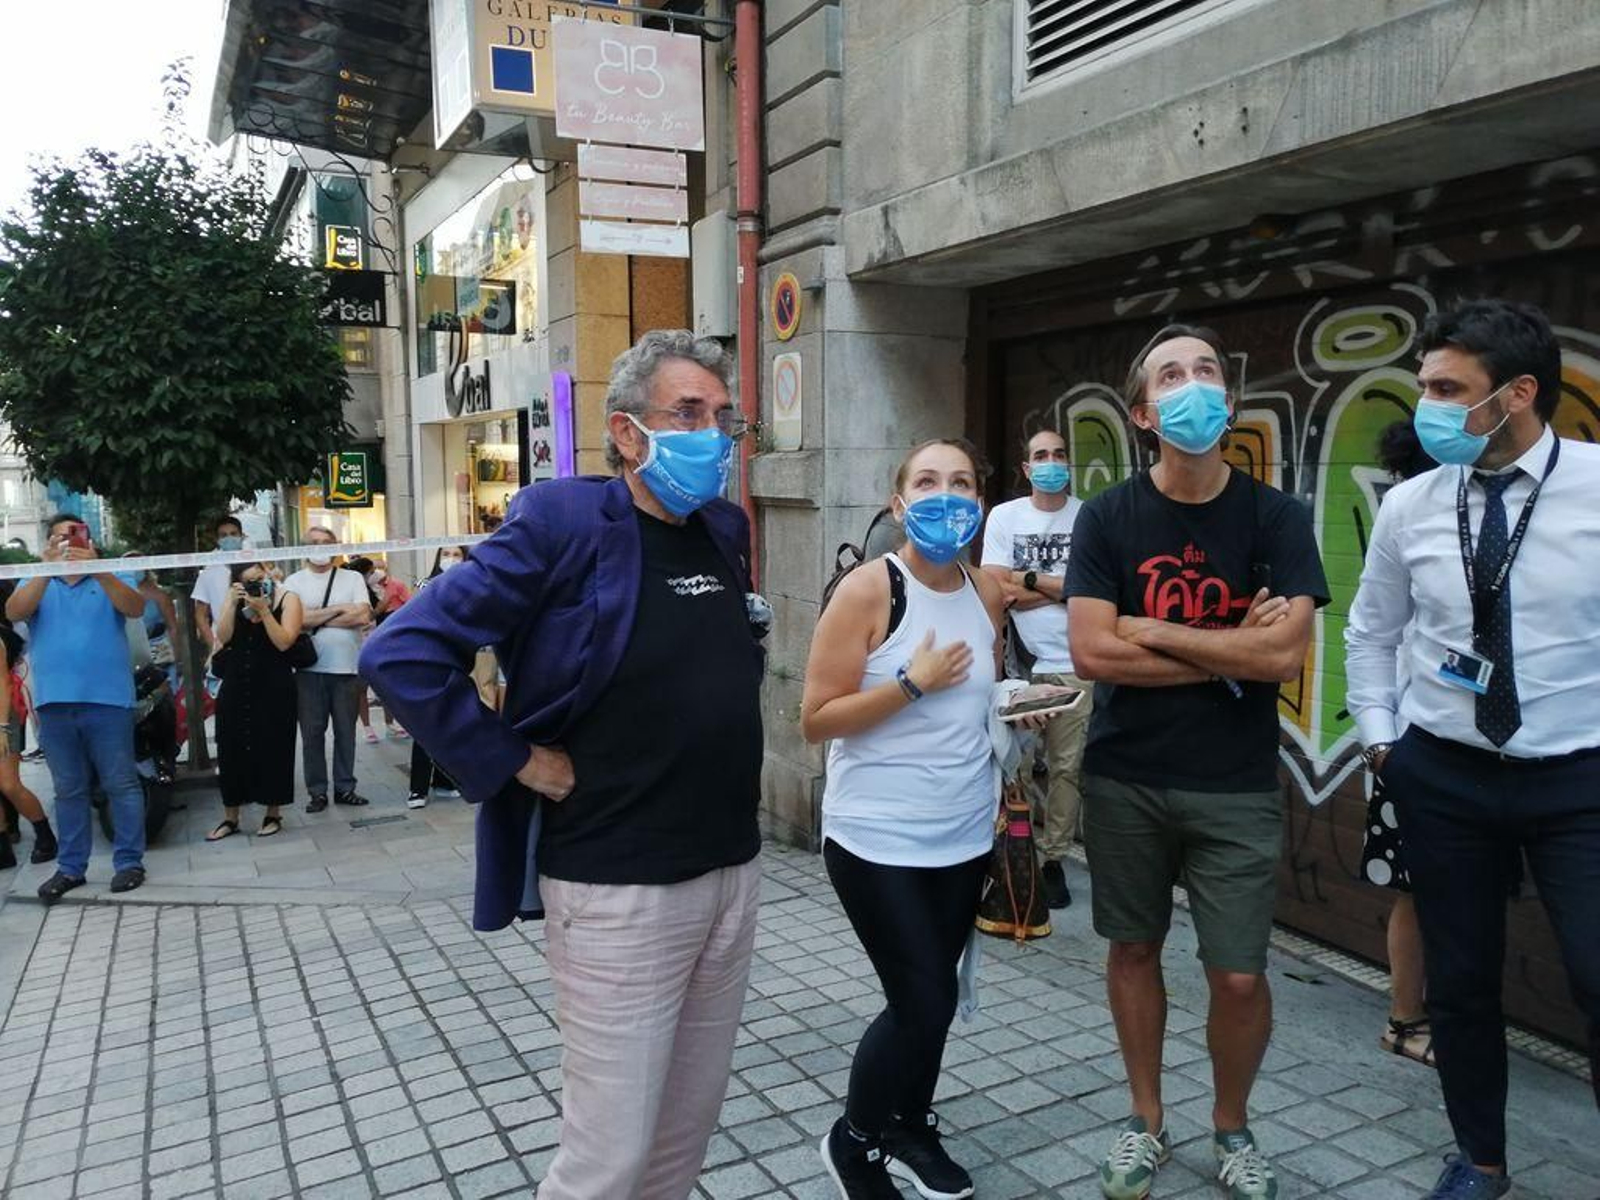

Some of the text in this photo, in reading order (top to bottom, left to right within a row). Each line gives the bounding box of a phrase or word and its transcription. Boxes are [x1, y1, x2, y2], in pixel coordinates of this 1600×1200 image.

[593, 104, 651, 131] Beauty
[340, 461, 362, 471] Casa
[340, 475, 363, 485] Libro
